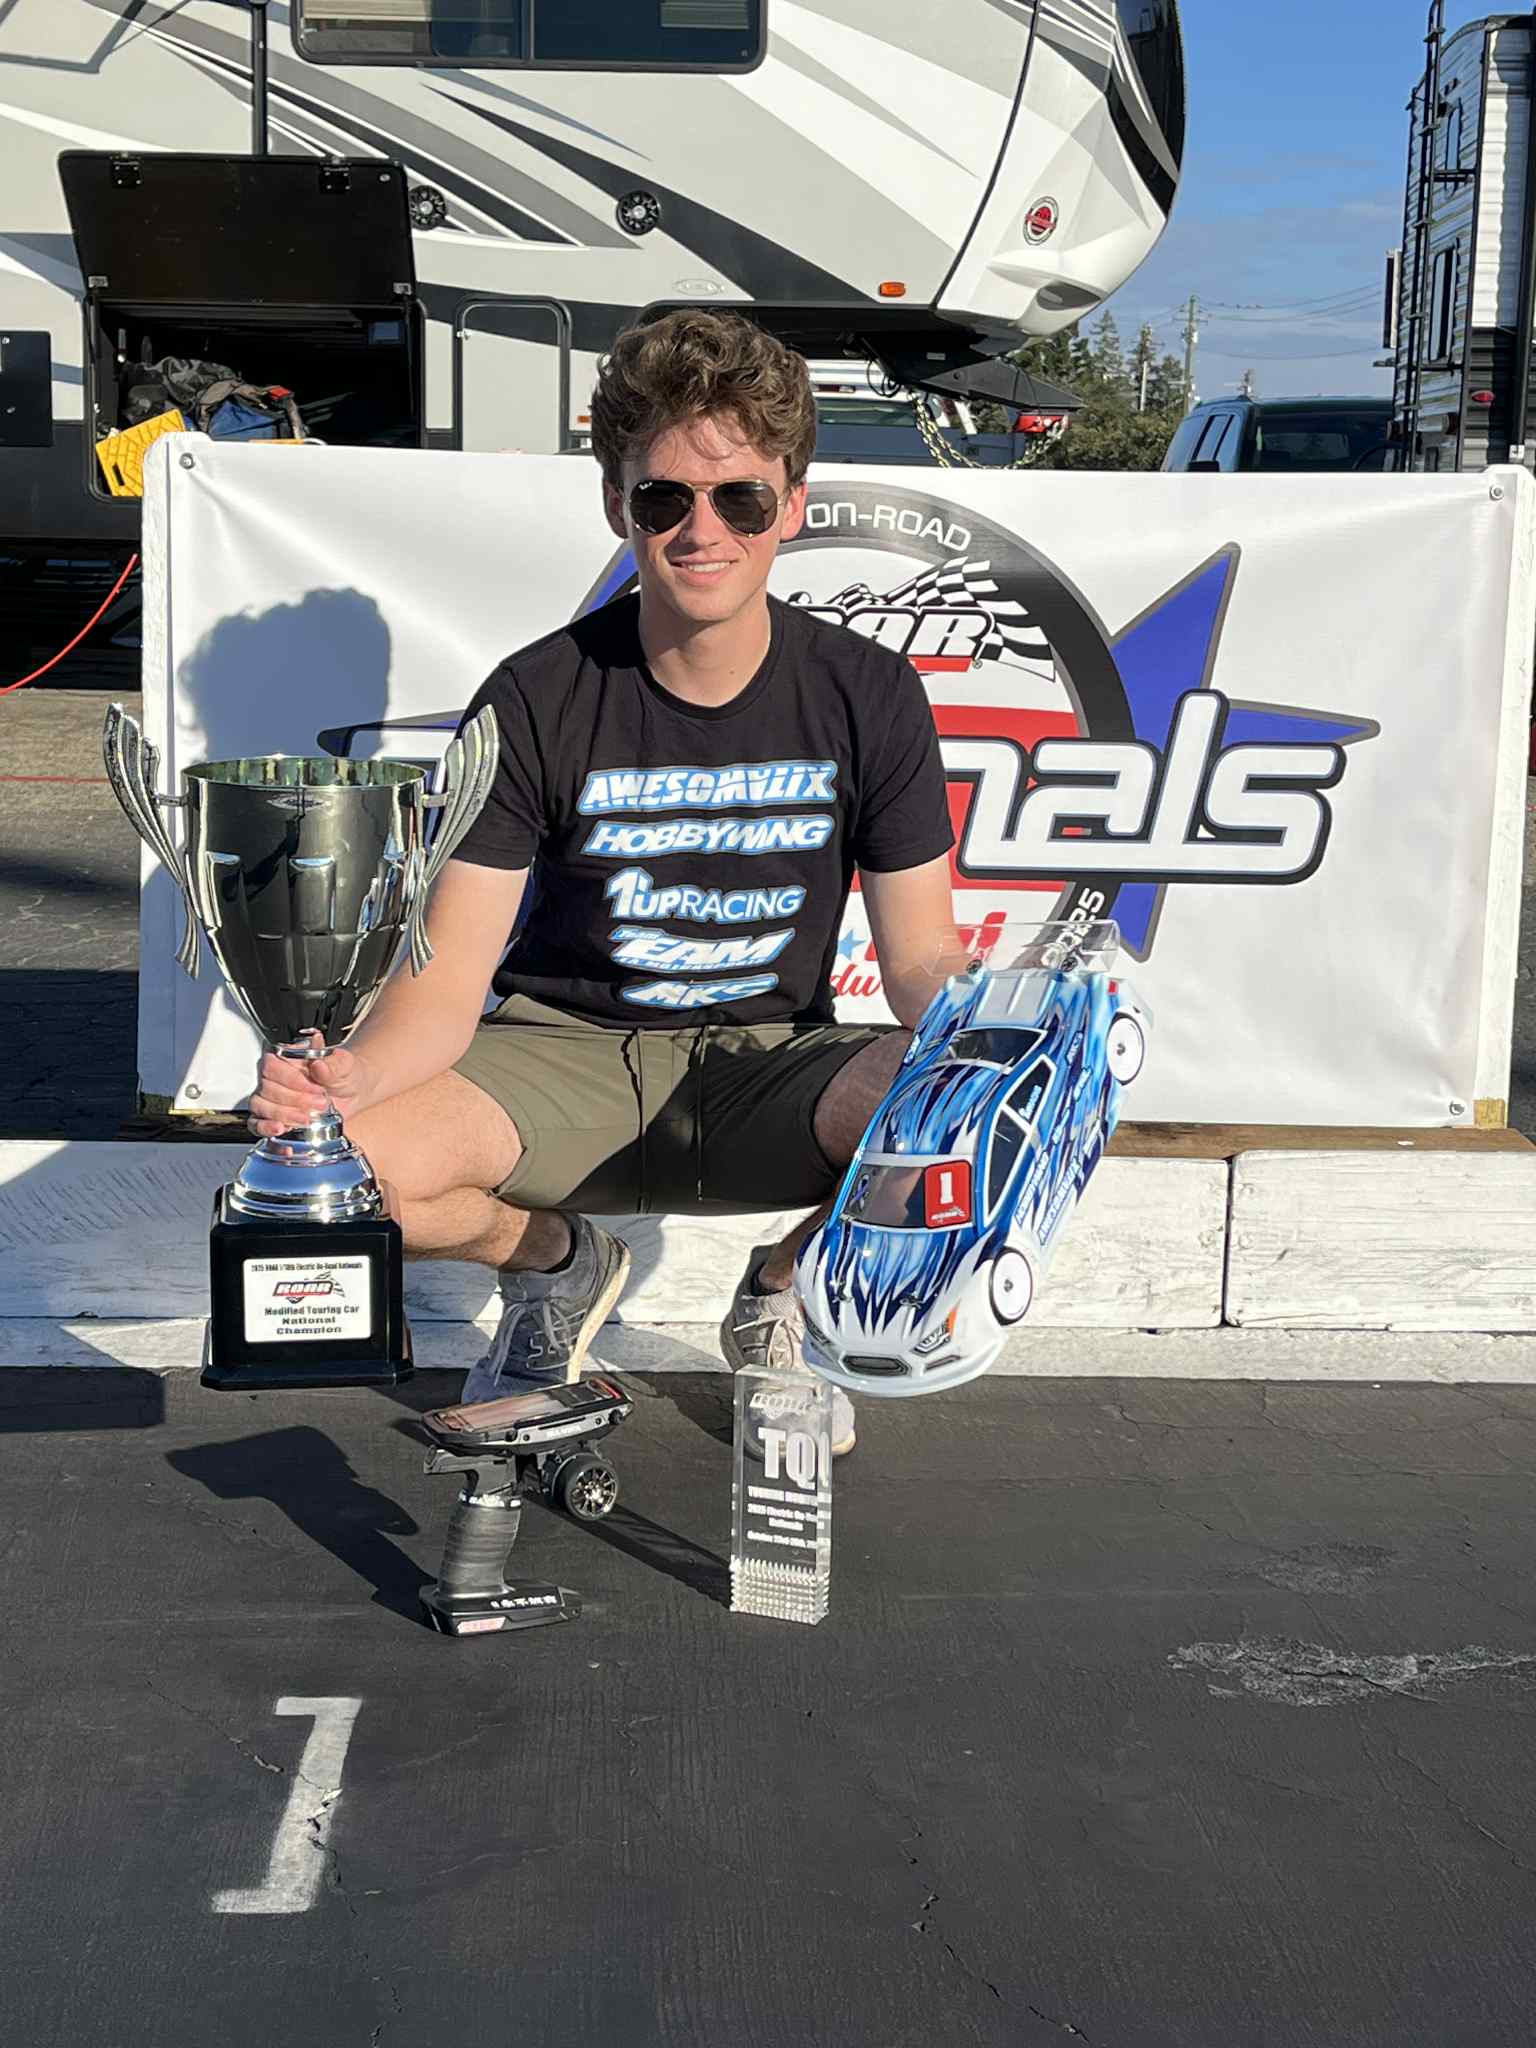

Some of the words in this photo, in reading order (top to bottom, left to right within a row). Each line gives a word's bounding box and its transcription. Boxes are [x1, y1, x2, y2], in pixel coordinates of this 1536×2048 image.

[805, 502, 972, 551] ON-ROAD
[939, 690, 1345, 884] nals
[588, 819, 829, 852] HOBBYWING
[940, 1171, 954, 1205] 1
[264, 1307, 305, 1316] Modified
[307, 1306, 342, 1315] Touring
[343, 1305, 360, 1314] Car
[282, 1316, 336, 1325] National
[276, 1326, 342, 1335] Champion
[758, 1426, 817, 1491] TQ
